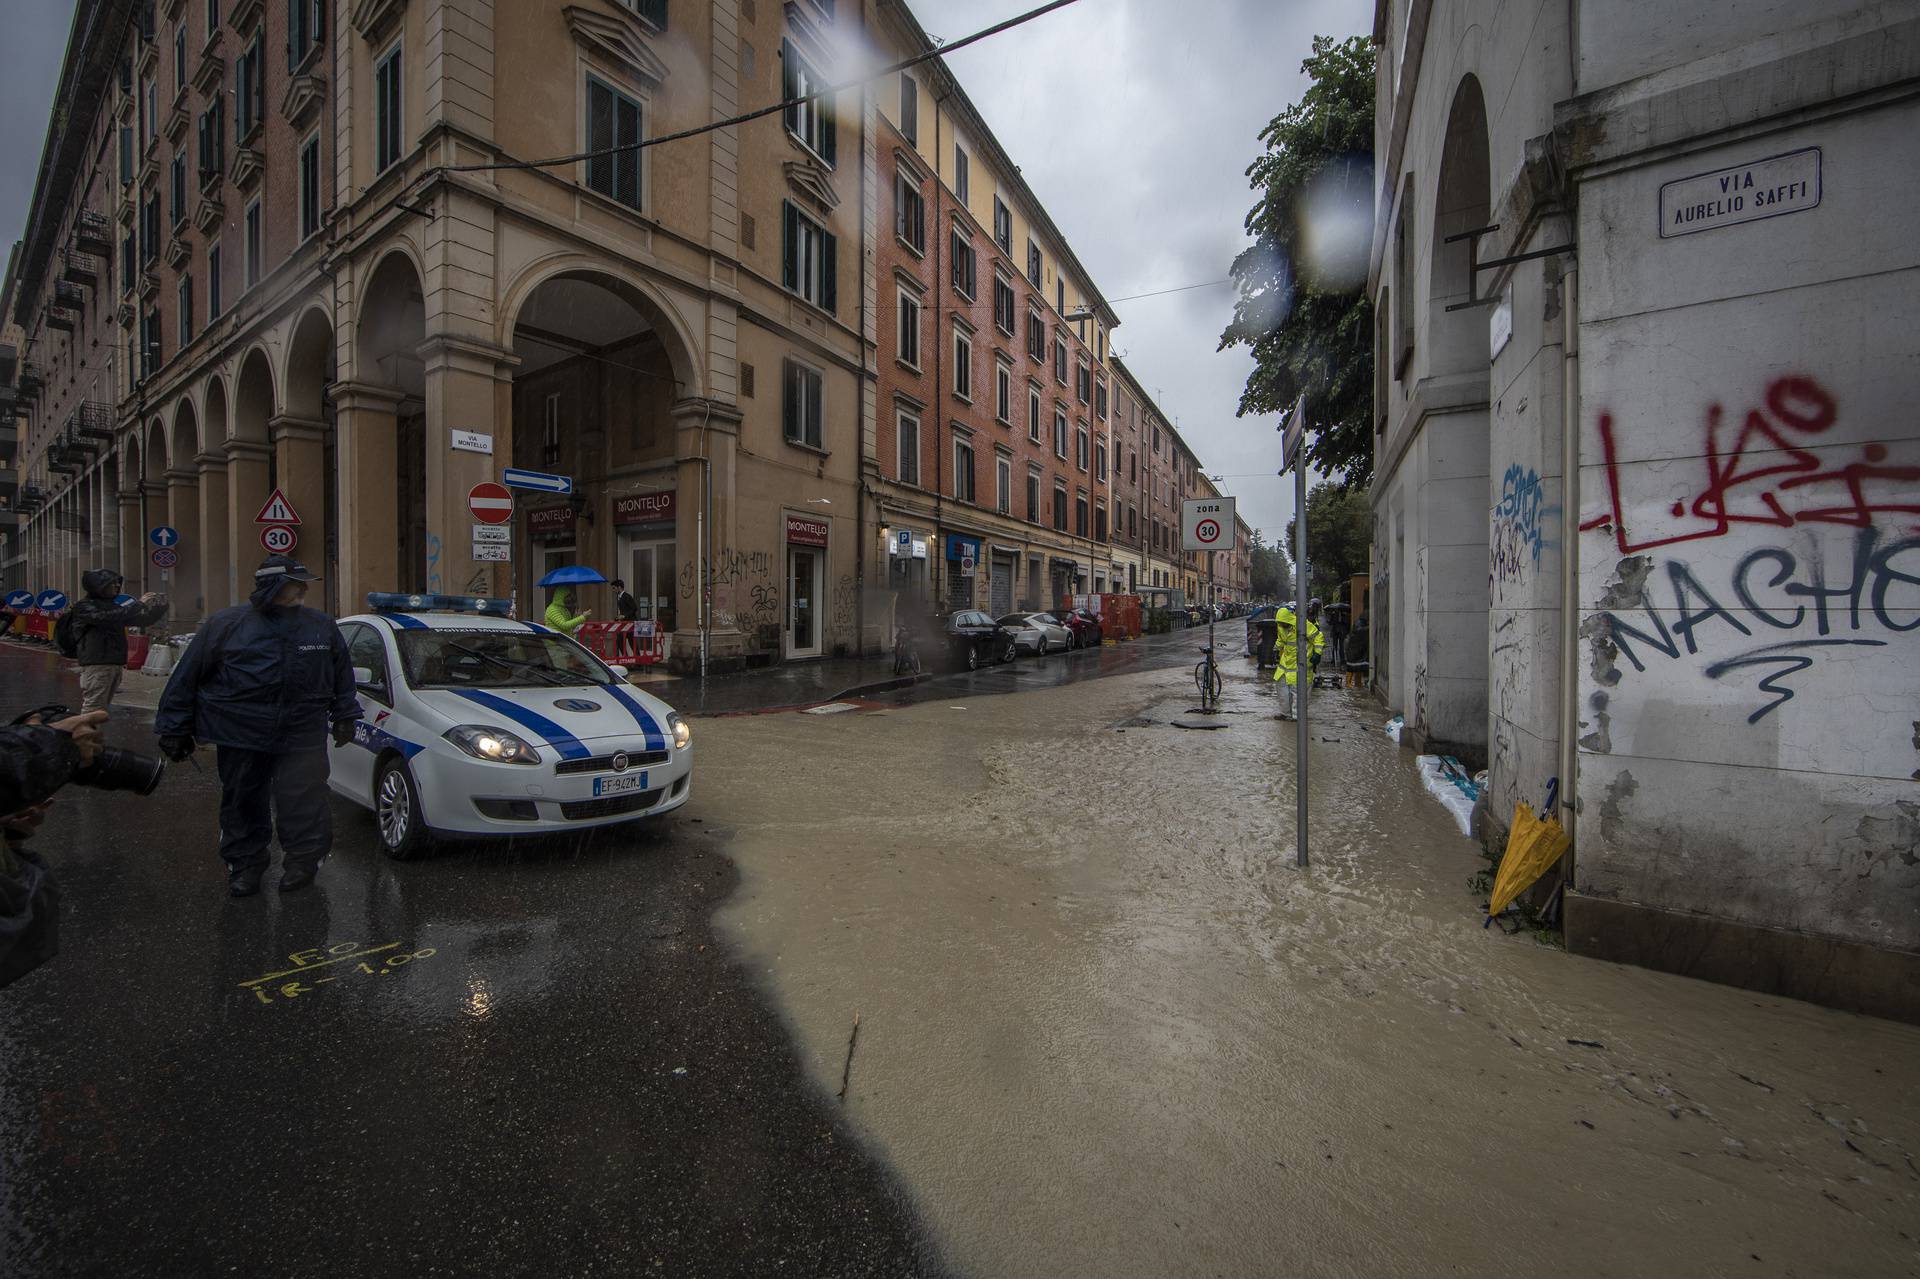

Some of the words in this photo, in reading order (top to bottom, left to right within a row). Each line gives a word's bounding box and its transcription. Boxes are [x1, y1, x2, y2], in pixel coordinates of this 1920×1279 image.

[1719, 171, 1754, 194] VIA
[1674, 196, 1744, 225] AURELIO
[1755, 181, 1807, 207] SAFFI
[458, 439, 488, 449] MONTELLO
[618, 494, 670, 513] MONTELLO
[1196, 504, 1221, 513] zona
[531, 507, 572, 523] MONTELLO
[787, 520, 827, 536] MONTELLO
[1201, 526, 1215, 537] 30
[268, 532, 289, 546] 30
[901, 533, 908, 543] P
